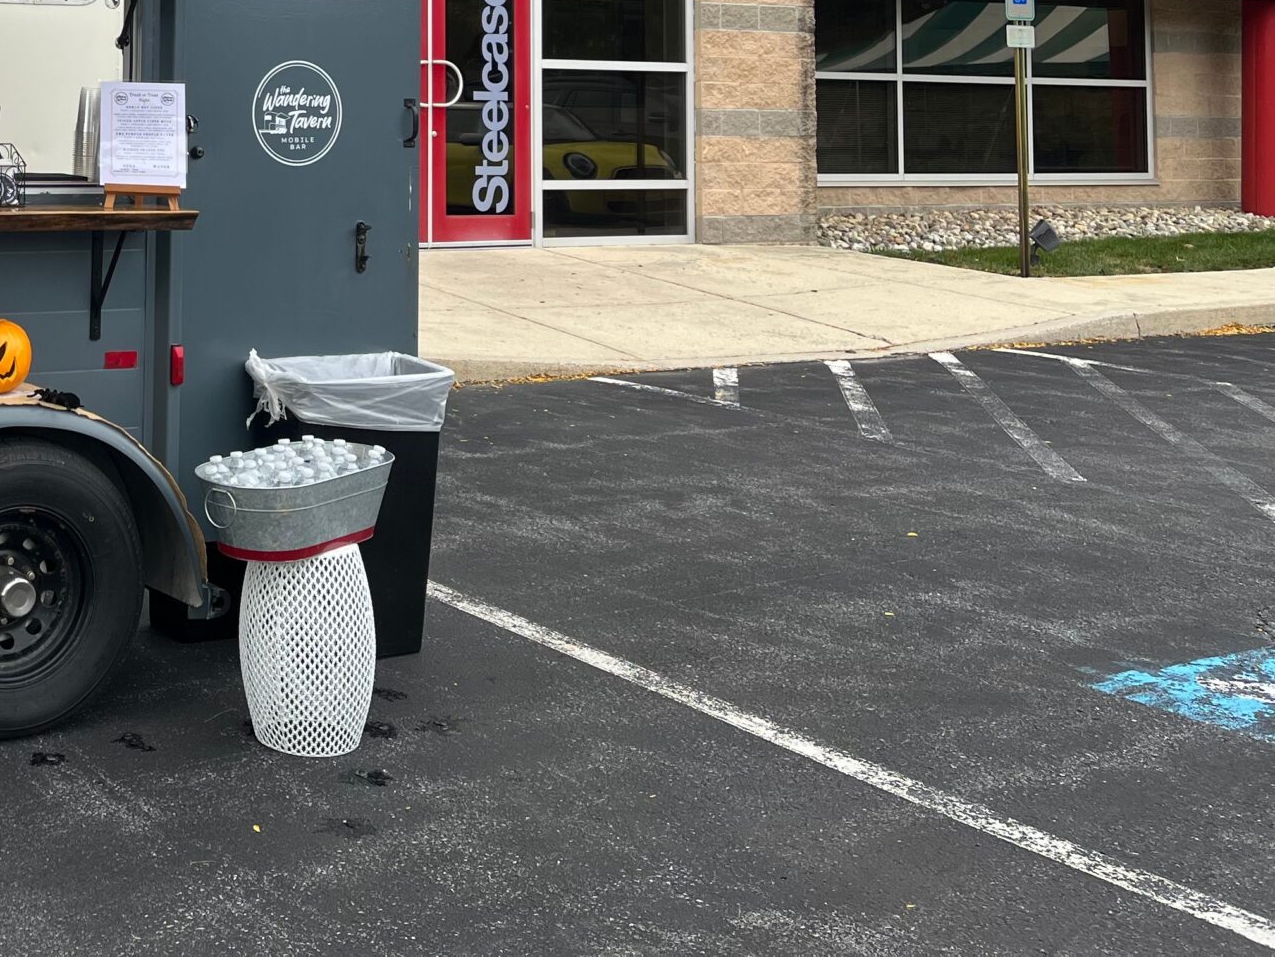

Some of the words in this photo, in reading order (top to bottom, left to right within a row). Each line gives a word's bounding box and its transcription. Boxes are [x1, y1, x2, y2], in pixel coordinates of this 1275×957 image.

[279, 85, 291, 95] the
[262, 87, 331, 114] Wandering
[288, 110, 332, 134] Tavern
[281, 136, 315, 144] MOBILE
